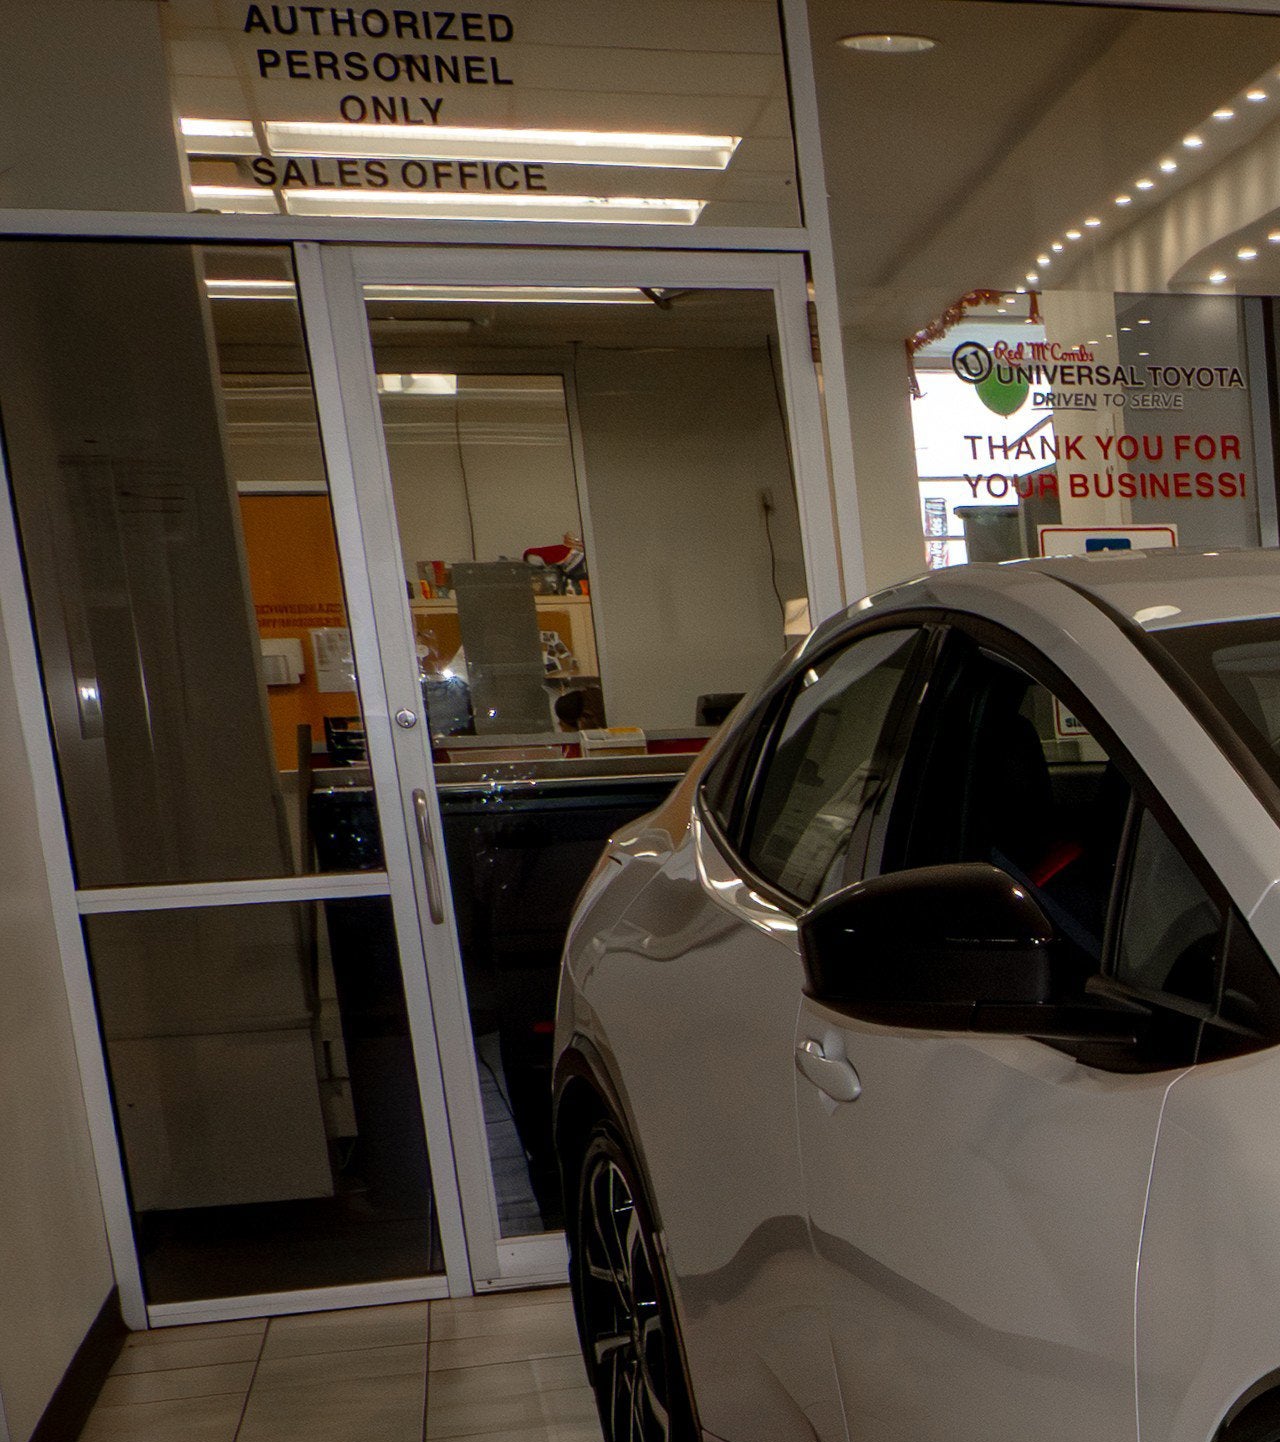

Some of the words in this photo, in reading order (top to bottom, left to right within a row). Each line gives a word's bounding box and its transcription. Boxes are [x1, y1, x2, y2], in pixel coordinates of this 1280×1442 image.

[244, 4, 514, 42] AUTHORIZED
[256, 49, 514, 85] PERSONNEL
[340, 95, 444, 125] ONLY
[252, 157, 389, 188] SALES
[401, 160, 548, 191] OFFICE
[994, 340, 1024, 369] Red
[1030, 342, 1094, 362] McCombs
[996, 364, 1144, 387] UNIVERSAL
[1148, 366, 1245, 388] TOYOTA
[1032, 392, 1098, 408] DRIVEN
[1103, 393, 1126, 407] TO
[1130, 394, 1184, 409] SERVE
[963, 435, 1087, 461] THANK
[1094, 435, 1164, 461] YOU
[1174, 435, 1241, 461] FOR
[963, 472, 1059, 499] YOUR
[1069, 472, 1246, 499] BUSINESS!
